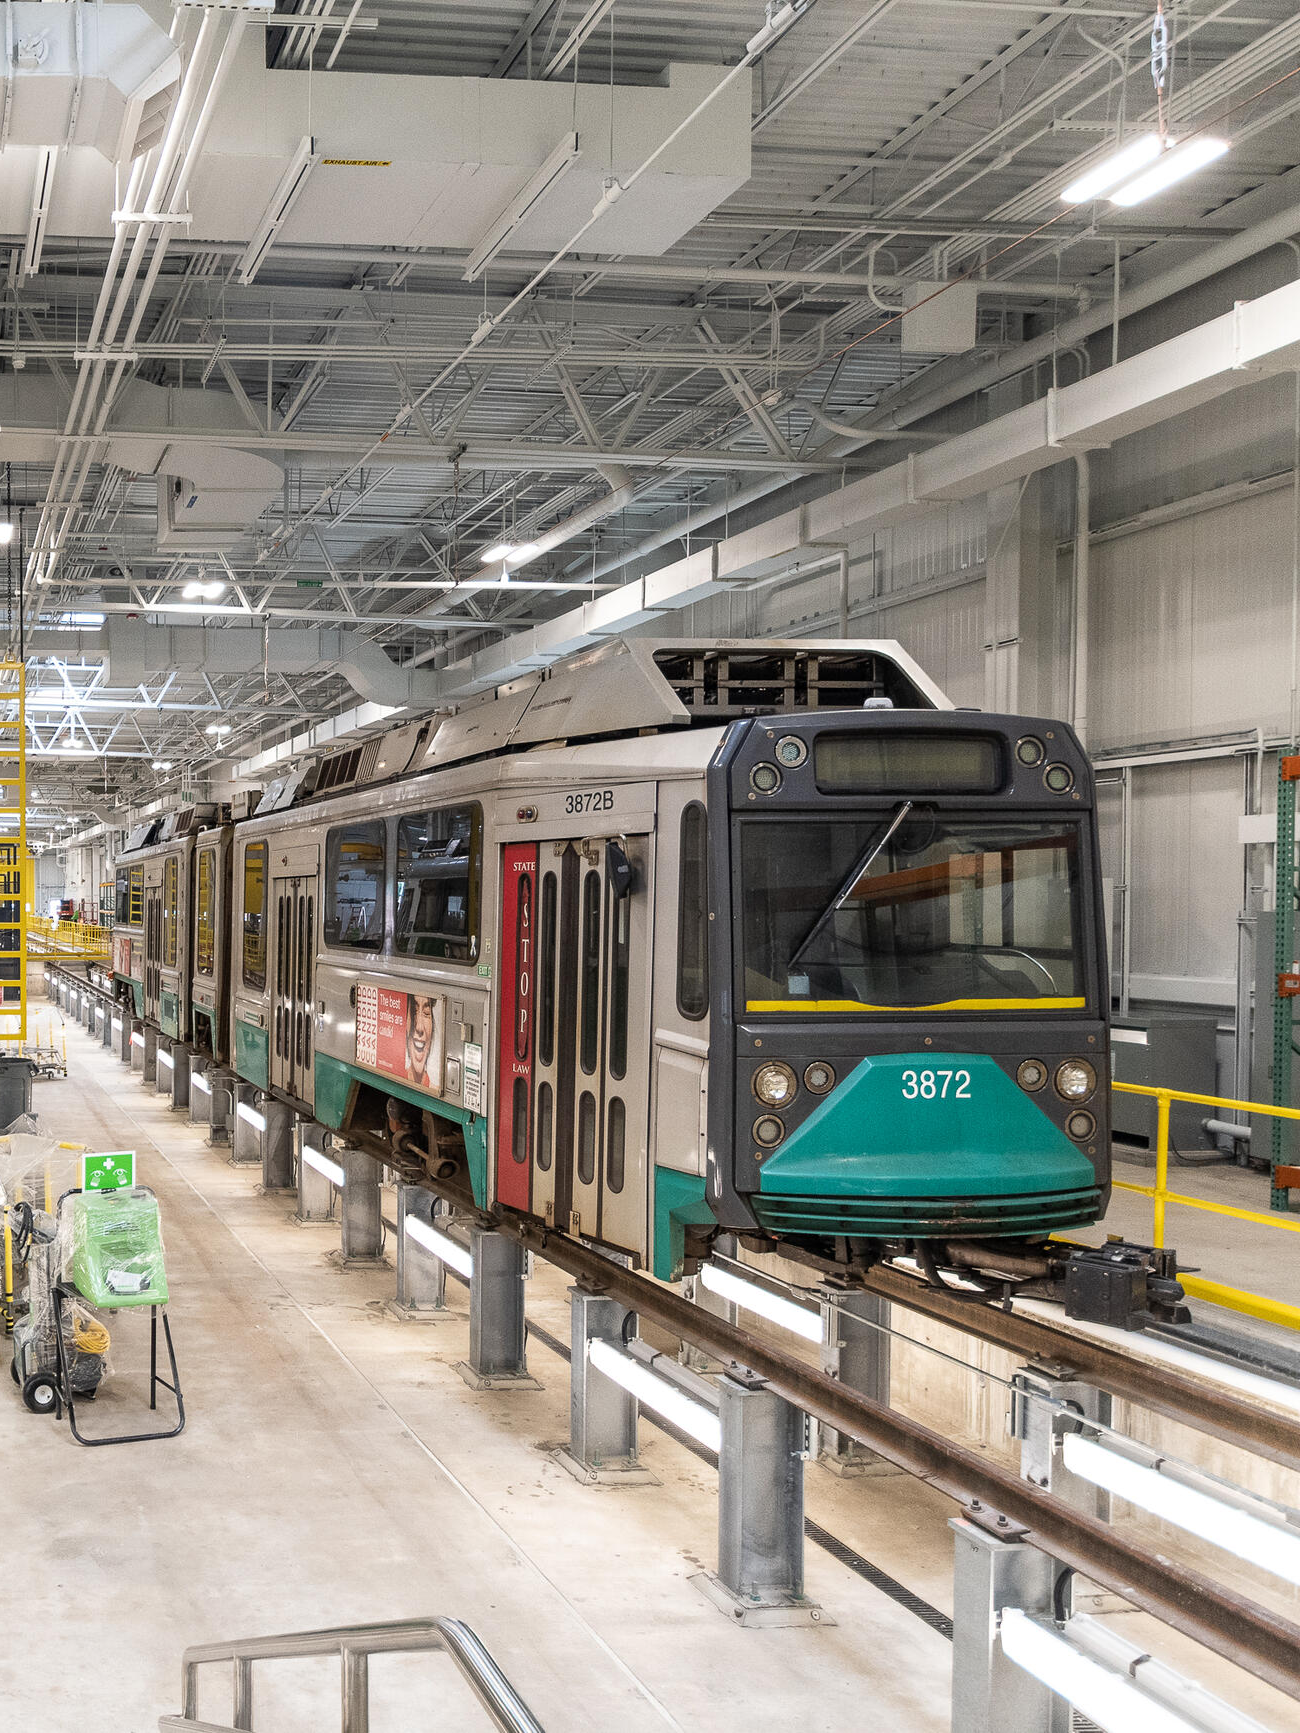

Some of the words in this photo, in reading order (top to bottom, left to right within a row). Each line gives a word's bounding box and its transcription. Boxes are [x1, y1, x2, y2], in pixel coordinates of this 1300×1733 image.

[565, 790, 614, 814] 3872B
[513, 861, 536, 872] STATE
[520, 903, 530, 1033] STOP
[379, 993, 389, 1007] The
[389, 995, 401, 1010] best
[379, 1010, 394, 1024] smiles
[394, 1014, 403, 1026] are
[512, 1063, 530, 1074] LAW
[902, 1070, 972, 1099] 3872
